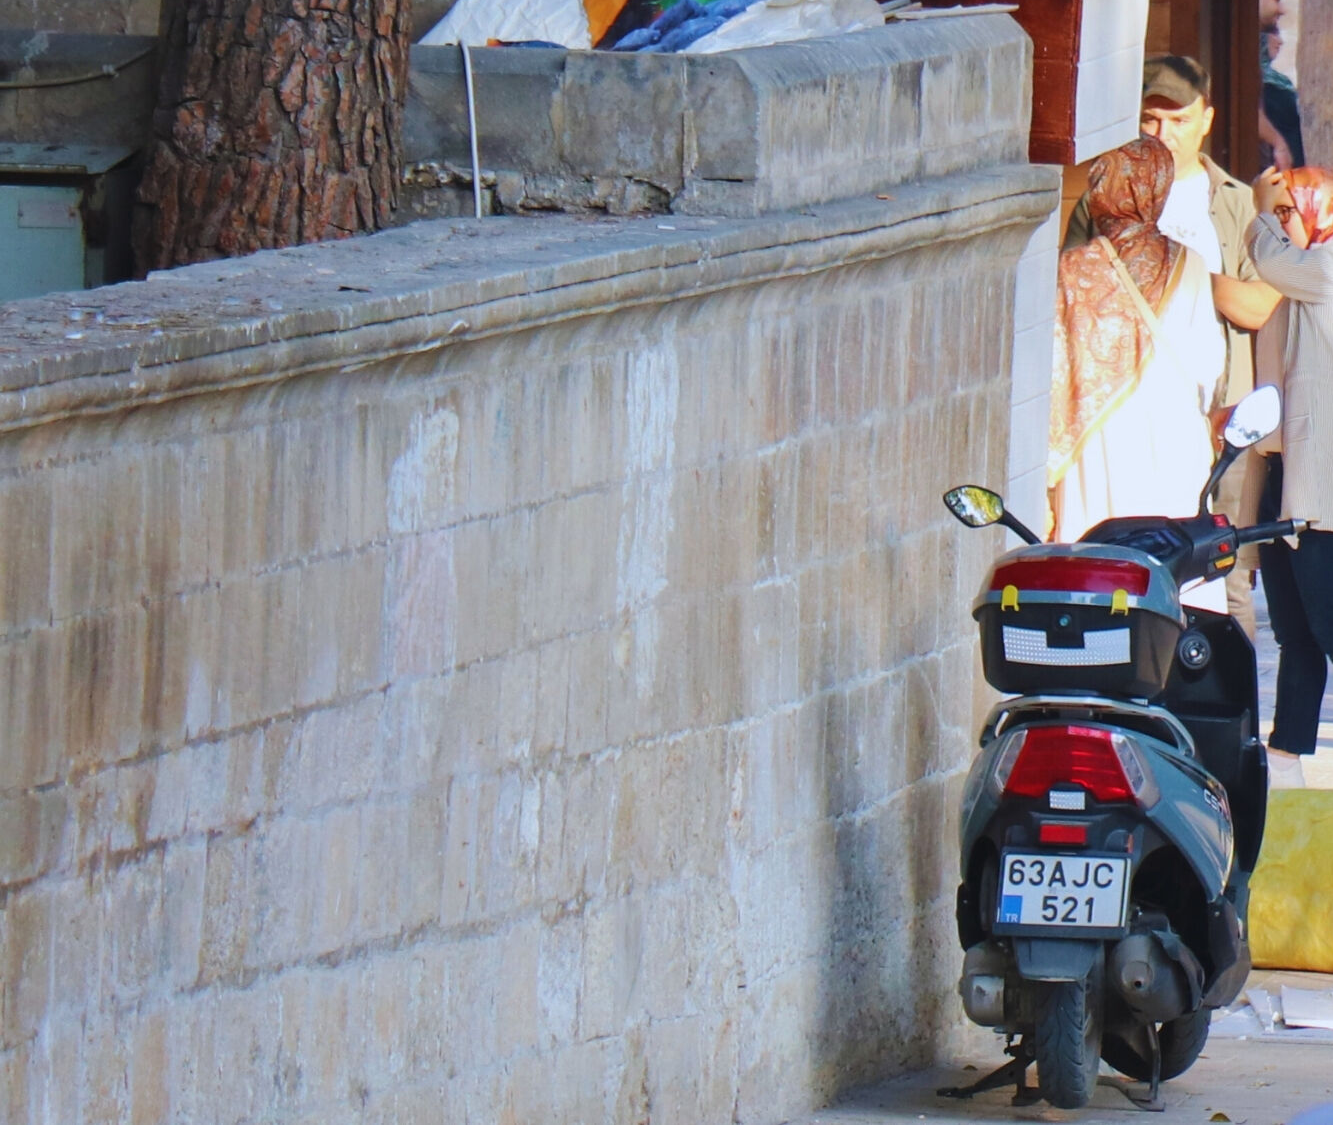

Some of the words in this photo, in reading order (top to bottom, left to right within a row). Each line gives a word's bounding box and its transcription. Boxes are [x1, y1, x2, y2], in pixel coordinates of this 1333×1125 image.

[1008, 859, 1114, 889] 63AJC
[1005, 913, 1018, 923] TR
[1041, 895, 1095, 923] 521
